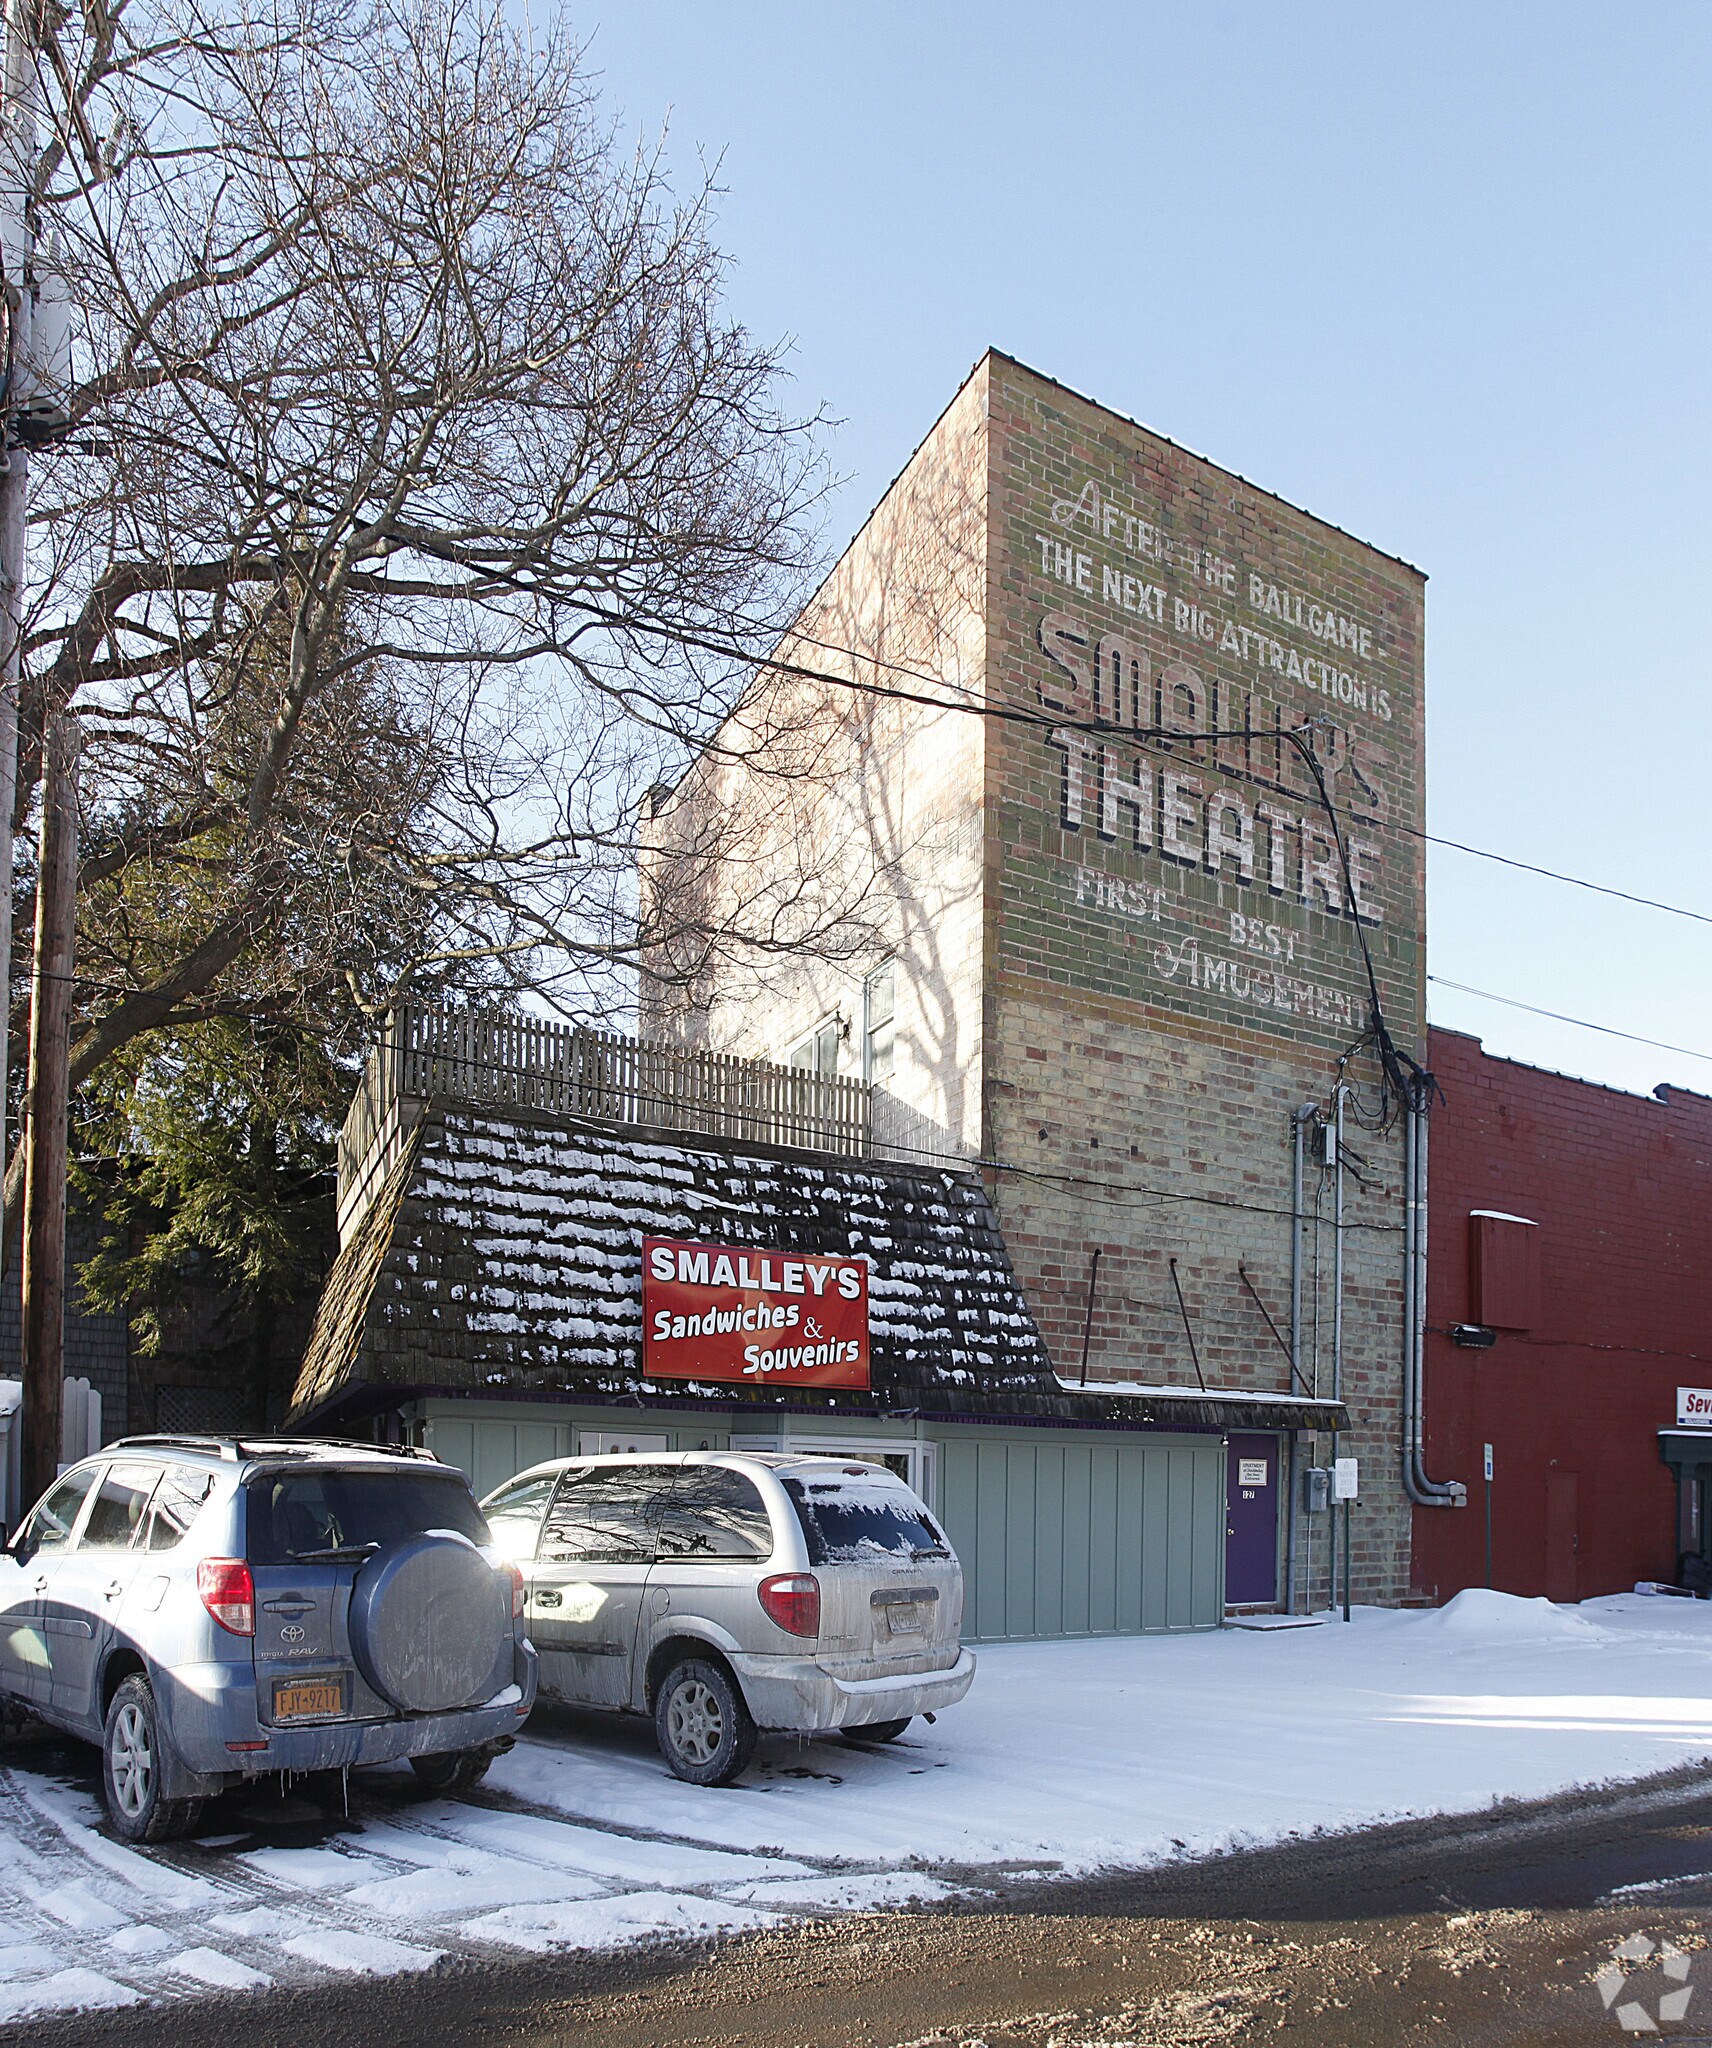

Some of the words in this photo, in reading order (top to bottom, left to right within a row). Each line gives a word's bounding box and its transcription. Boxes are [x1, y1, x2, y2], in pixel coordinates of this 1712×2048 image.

[1035, 533, 1093, 595] THE
[1102, 564, 1168, 624] NEXT
[1174, 596, 1214, 641] BIG
[1218, 619, 1367, 710] ATTRACTION
[1371, 686, 1393, 721] IS
[1045, 727, 1384, 928] THEATRE
[1075, 867, 1166, 922] FIRST
[1230, 912, 1299, 965] BEST
[1154, 936, 1372, 1029] AMUSEMENT
[650, 1247, 861, 1299] SMALLEY'S
[653, 1301, 800, 1341] Sandwiches
[803, 1316, 824, 1339] &
[743, 1336, 859, 1374] Souvenirs
[1686, 1393, 1712, 1413] Sev
[288, 1647, 325, 1656] RAV
